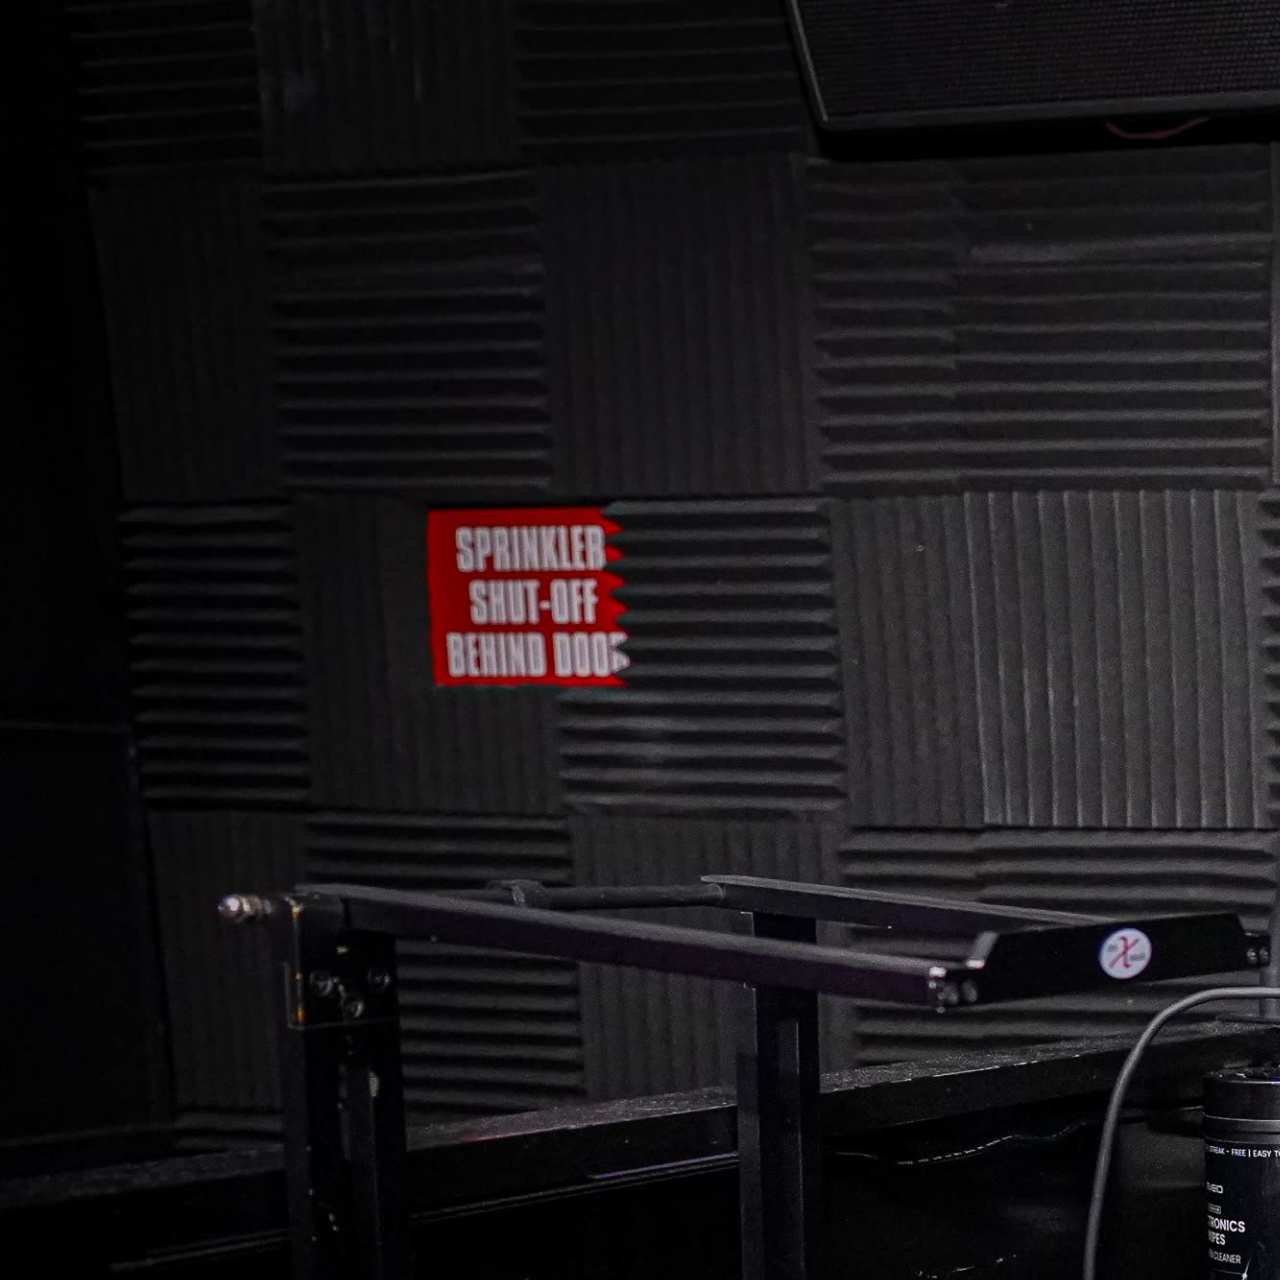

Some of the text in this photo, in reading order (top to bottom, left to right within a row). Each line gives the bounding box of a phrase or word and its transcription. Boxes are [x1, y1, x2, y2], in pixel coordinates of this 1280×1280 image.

[456, 525, 607, 572] SPRINKLER
[469, 579, 598, 624] SHUT-OFF
[447, 632, 547, 677] BEHIND
[1252, 1150, 1272, 1158] EASY
